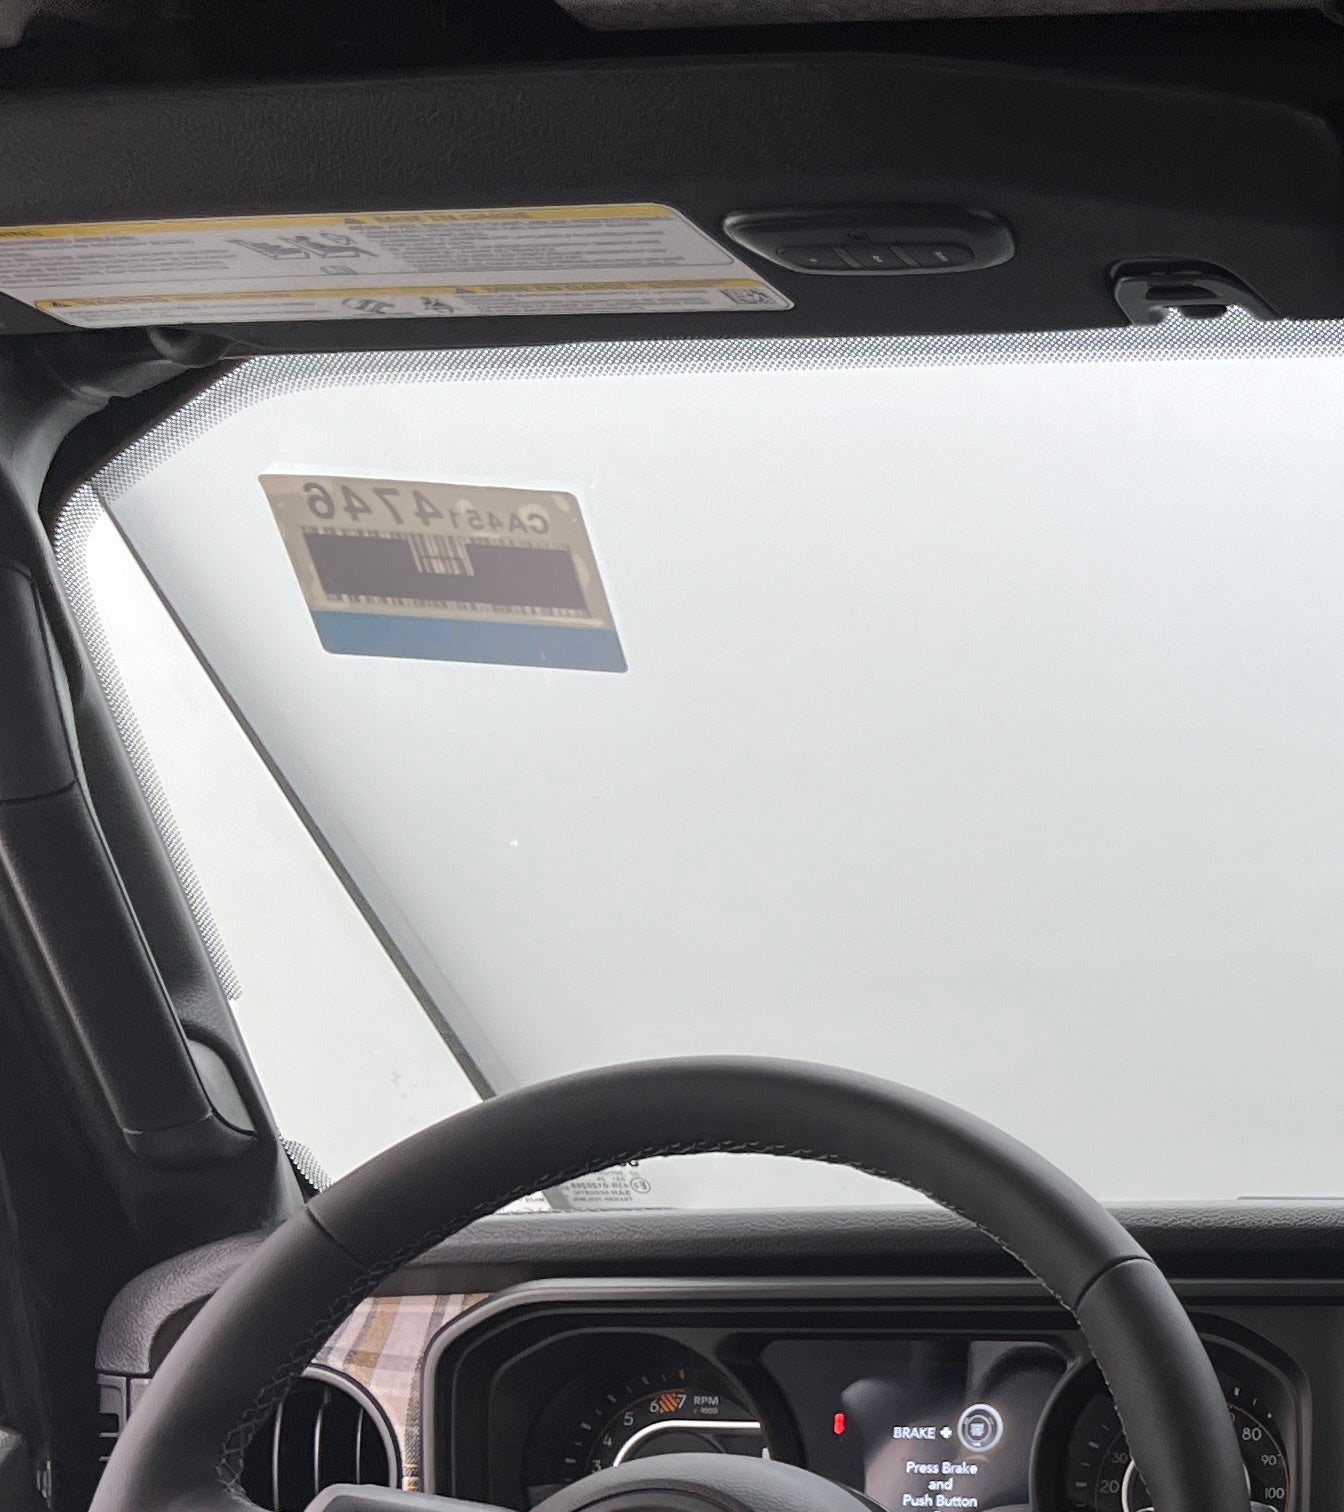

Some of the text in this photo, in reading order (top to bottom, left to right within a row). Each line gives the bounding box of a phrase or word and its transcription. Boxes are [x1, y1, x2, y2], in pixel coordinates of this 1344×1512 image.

[649, 1399, 660, 1413] 6
[677, 1394, 688, 1408] 7
[693, 1396, 719, 1406] RPM
[623, 1411, 634, 1426] 5
[892, 1426, 936, 1440] BRAKE
[1241, 1427, 1262, 1441] 80
[602, 1434, 612, 1447] 4
[1111, 1452, 1128, 1464] 30
[1261, 1455, 1277, 1467] 90
[906, 1461, 978, 1475] Press Brake
[928, 1478, 953, 1491] and
[1100, 1480, 1119, 1493] 20
[1264, 1487, 1285, 1499] 100
[902, 1493, 978, 1508] Push Button
